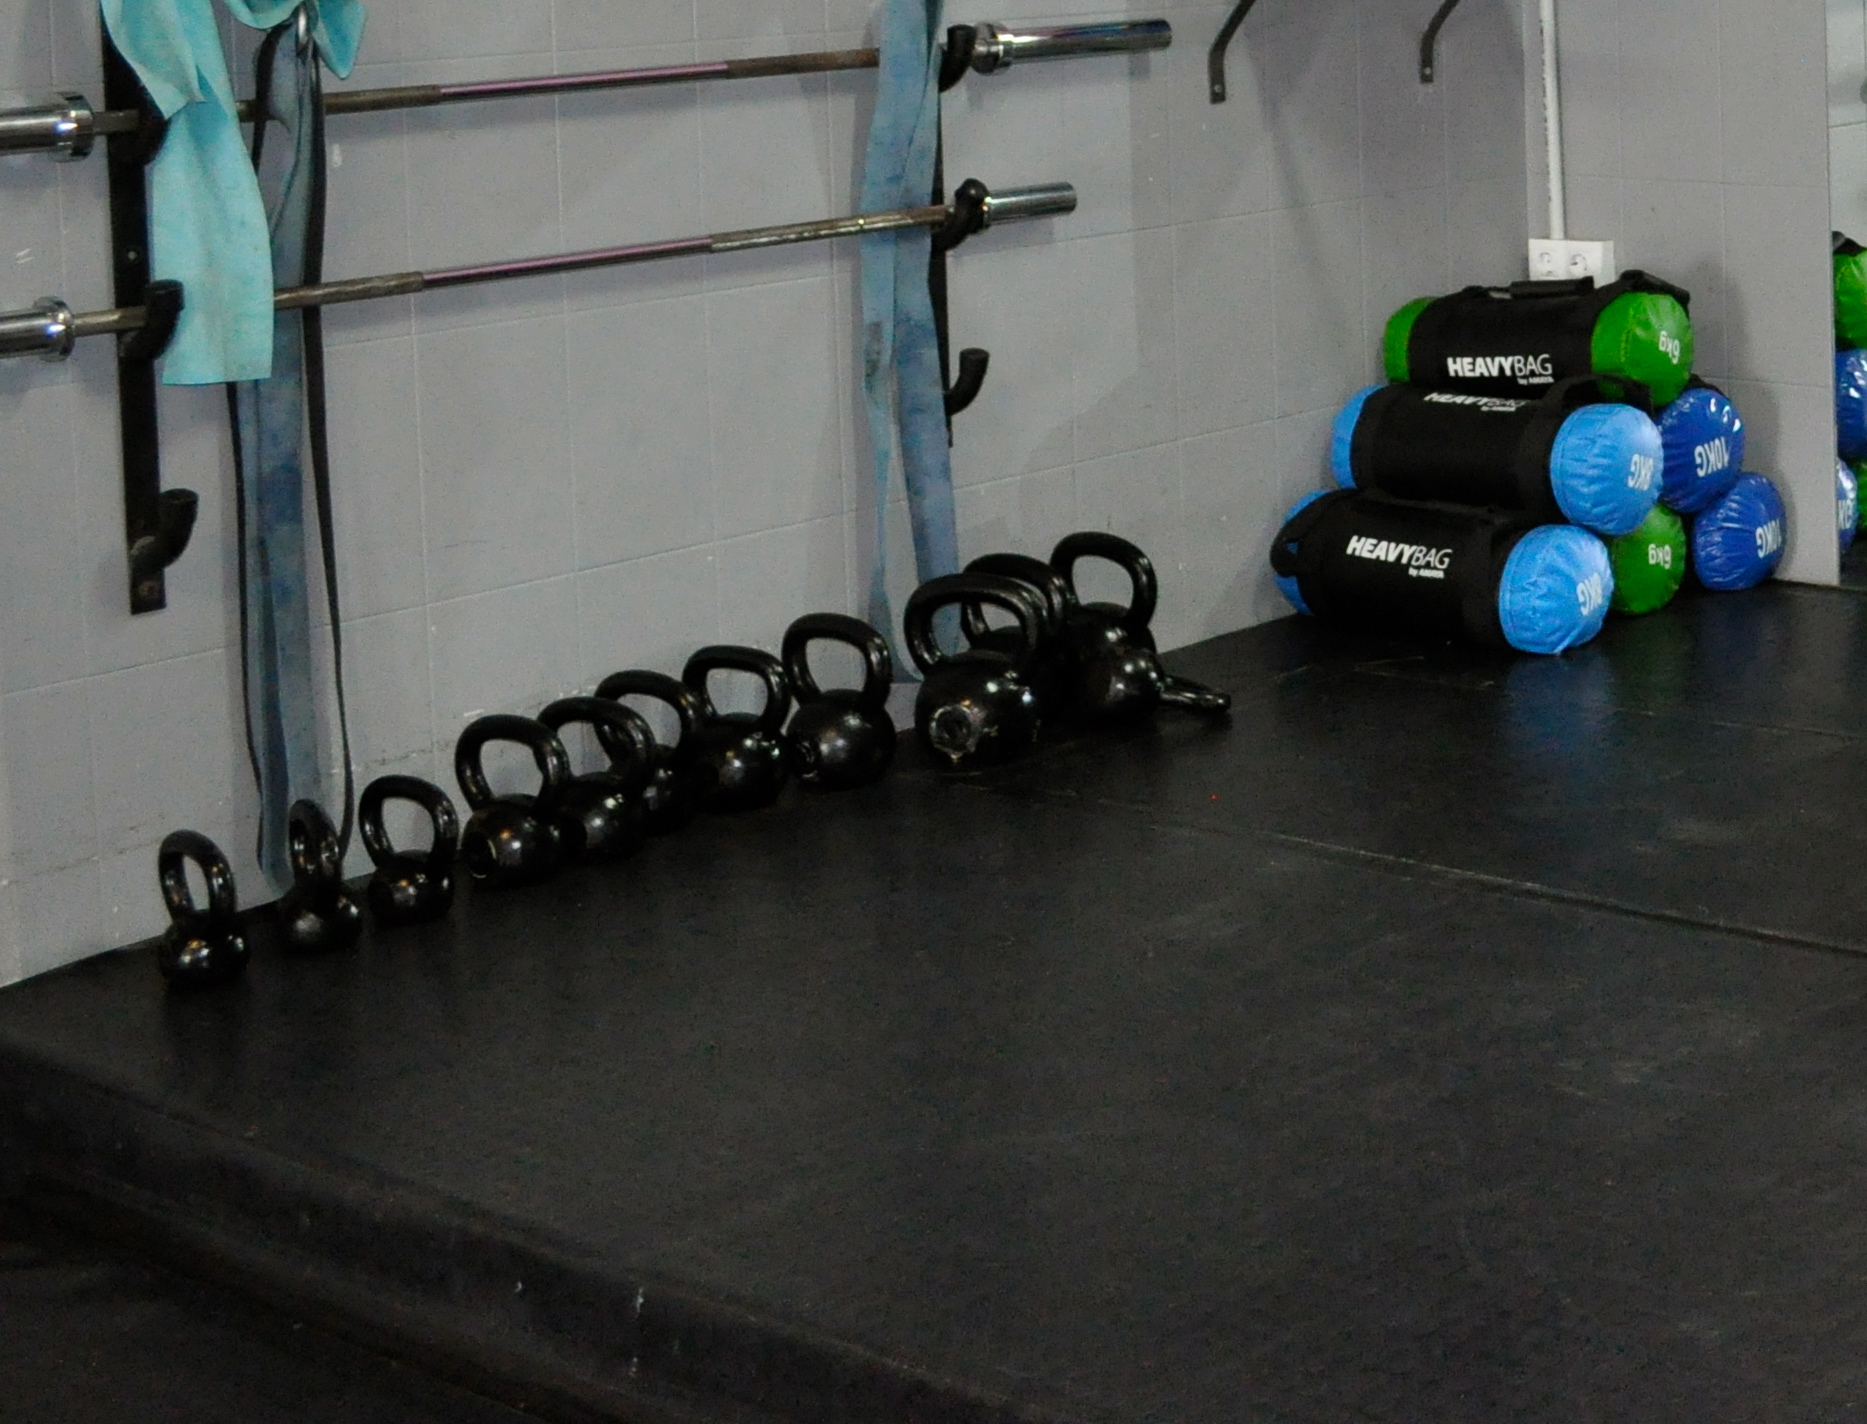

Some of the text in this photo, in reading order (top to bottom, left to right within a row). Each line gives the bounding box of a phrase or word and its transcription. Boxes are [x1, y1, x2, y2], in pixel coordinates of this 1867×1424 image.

[1447, 353, 1553, 377] HEAVYBAG
[1658, 330, 1681, 365] 6kg
[1694, 436, 1730, 477] 10KG
[1346, 534, 1453, 569] HEAVYBAG
[1648, 543, 1673, 570] 6kg
